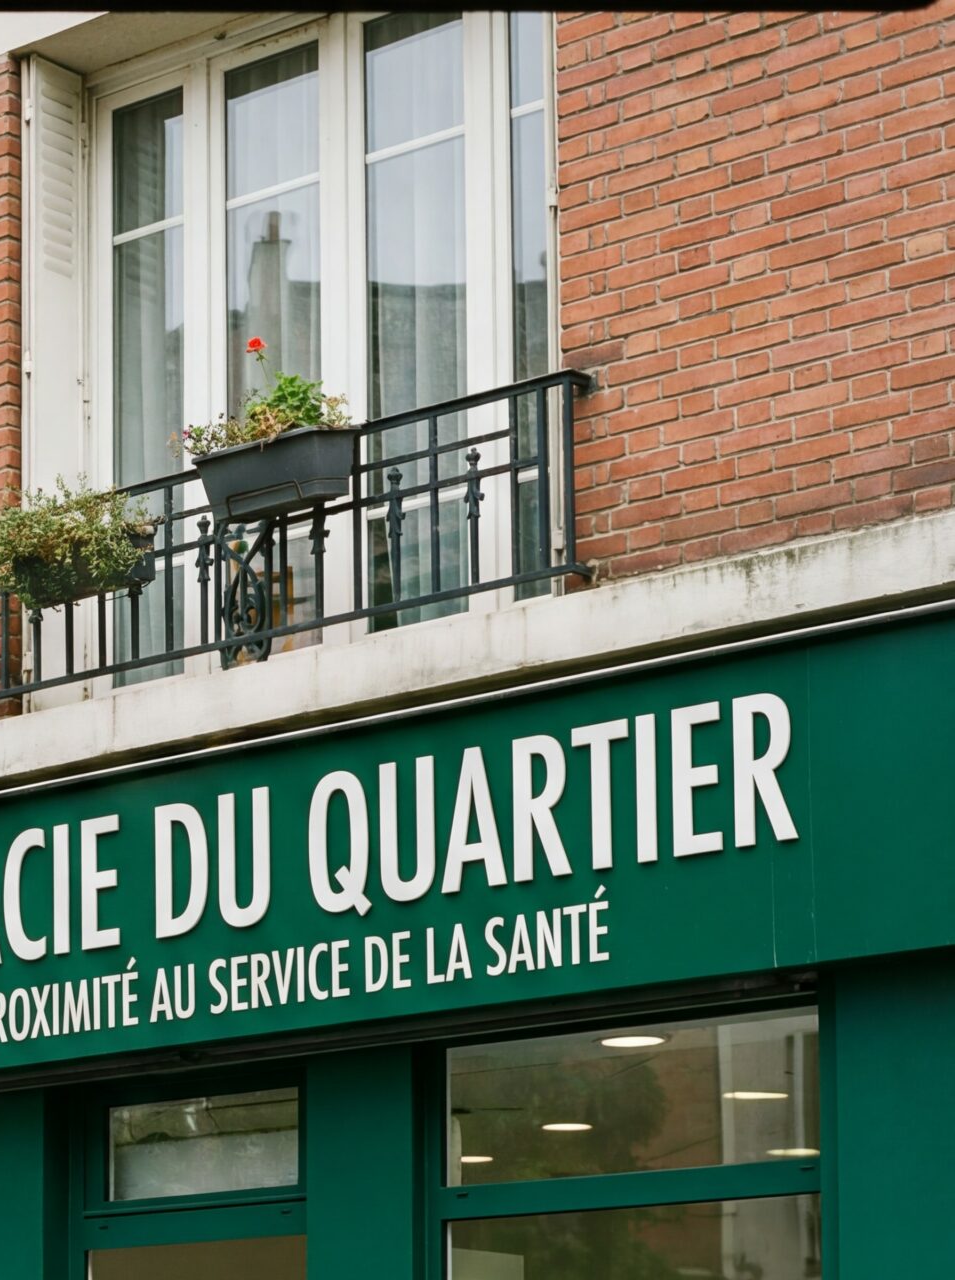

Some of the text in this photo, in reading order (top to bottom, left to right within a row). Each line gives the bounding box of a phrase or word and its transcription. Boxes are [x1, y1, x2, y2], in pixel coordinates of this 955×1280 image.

[154, 787, 271, 938] DU
[308, 692, 799, 916] QUARTIER
[149, 963, 196, 1023] AU
[208, 939, 351, 1014] SERVICE
[364, 930, 412, 993] DE
[426, 923, 473, 985] LA
[484, 884, 610, 976] SANTÉ
